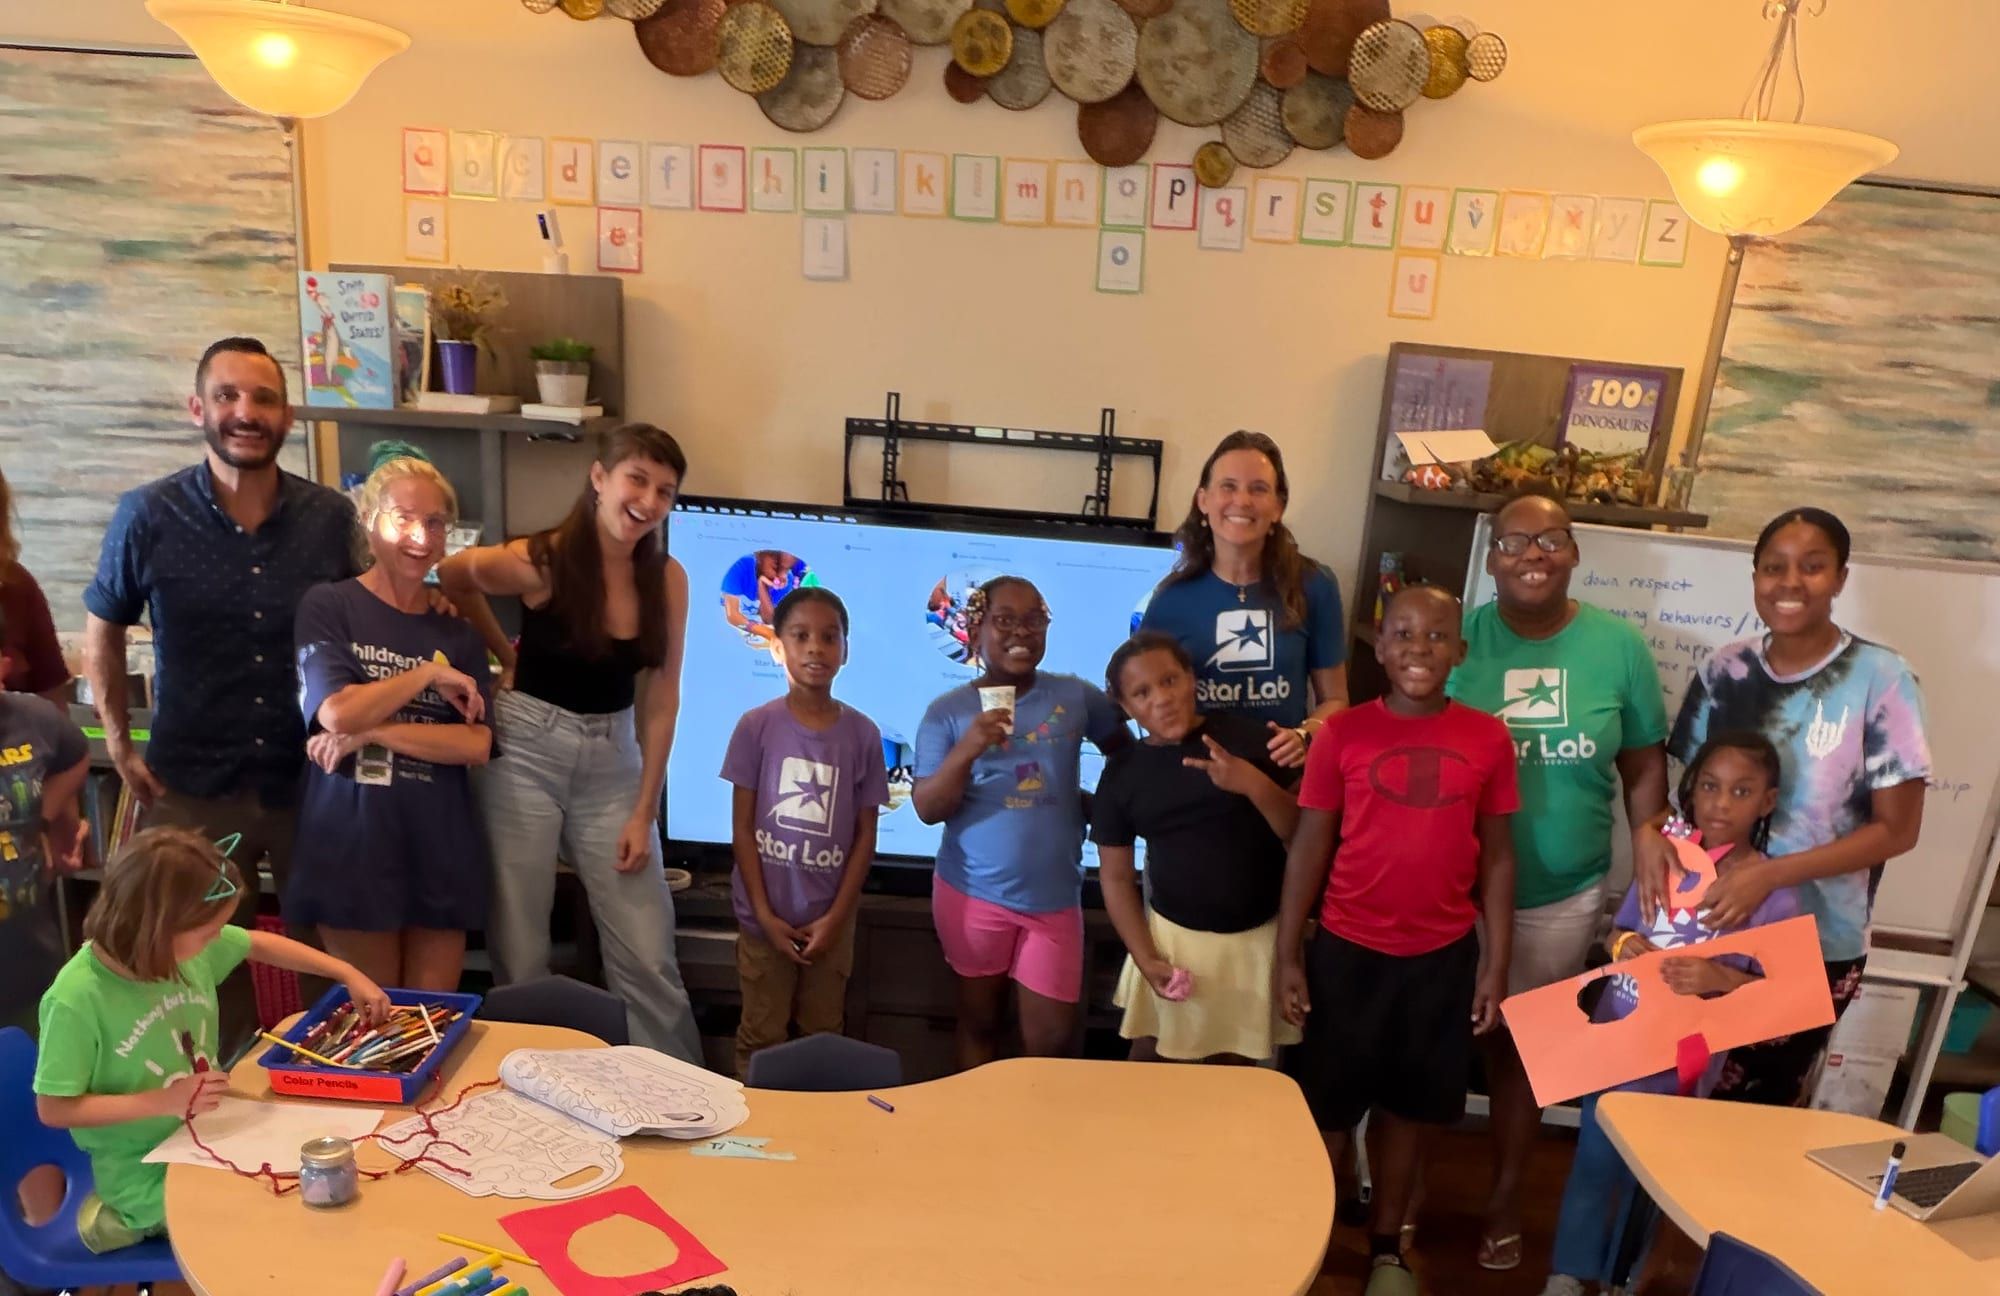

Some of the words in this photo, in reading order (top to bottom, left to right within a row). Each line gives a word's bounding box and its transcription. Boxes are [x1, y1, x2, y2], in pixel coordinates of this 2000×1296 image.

[561, 147, 578, 183] d
[611, 155, 632, 180] e
[660, 154, 678, 190] f
[762, 157, 782, 194] h
[915, 163, 936, 197] k
[1017, 181, 1039, 199] m
[1065, 178, 1085, 202] n
[1118, 178, 1137, 198] o
[1169, 177, 1187, 210] p
[1268, 194, 1283, 217] r
[1369, 191, 1387, 229] t
[1414, 200, 1433, 225] u
[418, 216, 435, 237] a
[609, 226, 627, 247] e
[1111, 246, 1130, 266] o
[1408, 273, 1428, 294] u
[1587, 379, 1643, 409] 100
[1570, 412, 1650, 432] DINOSAURS
[1629, 576, 1695, 598] respect
[1196, 678, 1242, 702] Star
[1248, 675, 1291, 700] Lab
[1540, 732, 1597, 758] Lab
[755, 828, 797, 861] Star
[802, 840, 844, 868] Lab
[115, 1004, 165, 1058] Nothing
[283, 1075, 314, 1087] Color
[317, 1077, 359, 1090] Pencils
